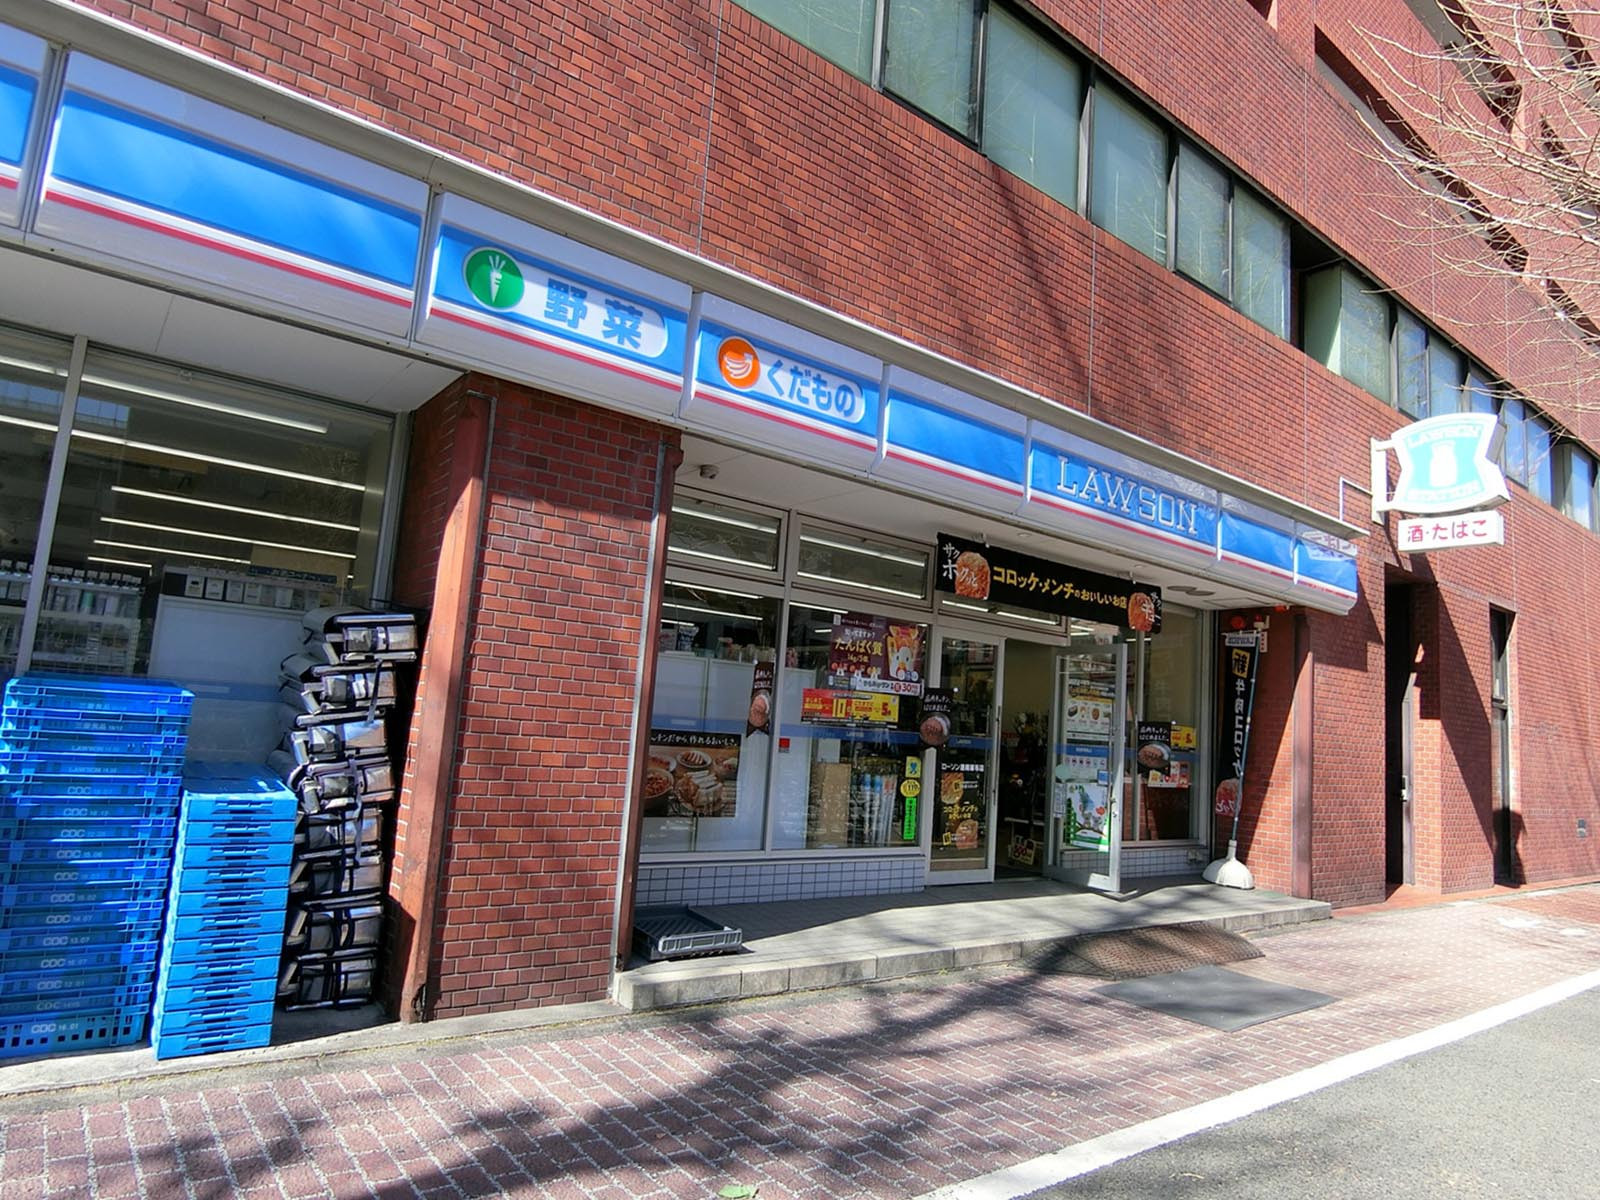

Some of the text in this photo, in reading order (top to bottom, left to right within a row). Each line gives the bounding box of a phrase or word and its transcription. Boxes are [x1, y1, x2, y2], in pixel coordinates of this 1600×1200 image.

[543, 277, 642, 350] 野菜
[766, 359, 857, 417] くだもの
[1056, 455, 1199, 536] LAWSON
[834, 637, 883, 657] たんぱく質
